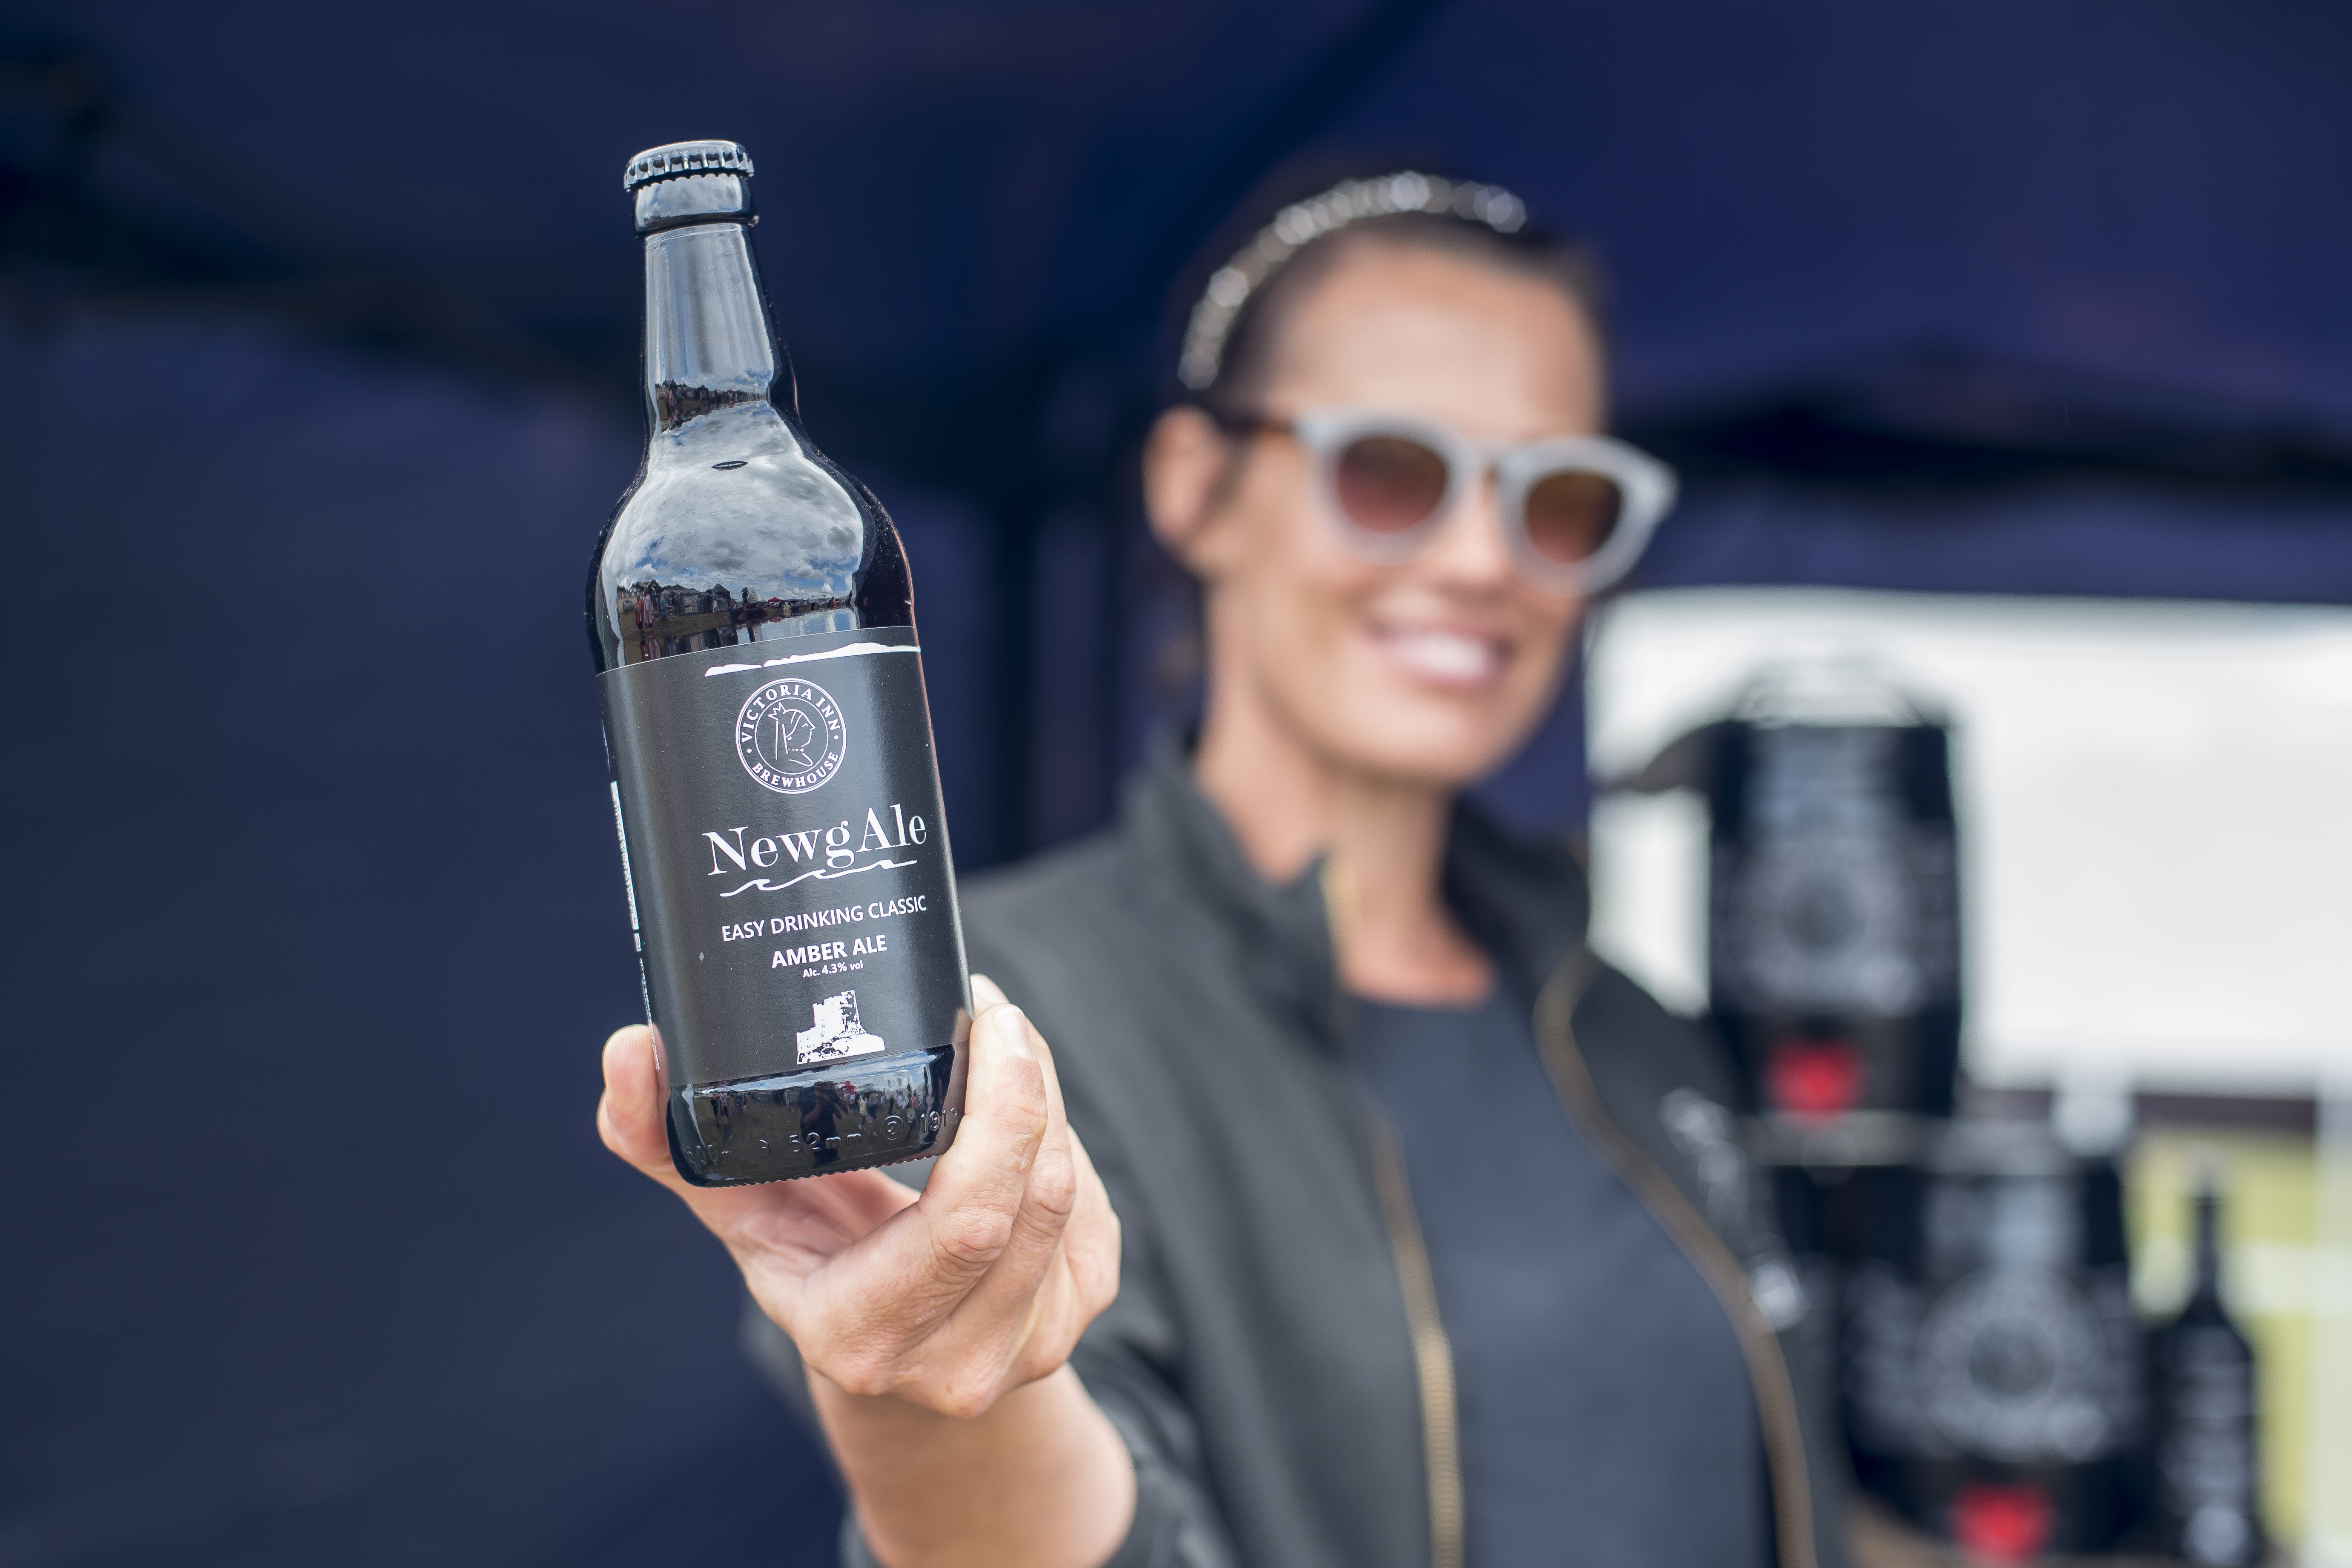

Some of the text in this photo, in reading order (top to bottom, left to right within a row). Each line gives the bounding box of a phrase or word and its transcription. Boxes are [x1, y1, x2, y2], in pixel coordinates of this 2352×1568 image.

[741, 684, 841, 743] VICTORIA INN
[752, 752, 839, 787] BREWHOUSE
[701, 803, 927, 876] NewgAle
[721, 895, 927, 942] EASY DRINKING CLASSIC
[771, 934, 888, 969] AMBER ALE
[802, 960, 864, 978] Alc. 4.3% vol
